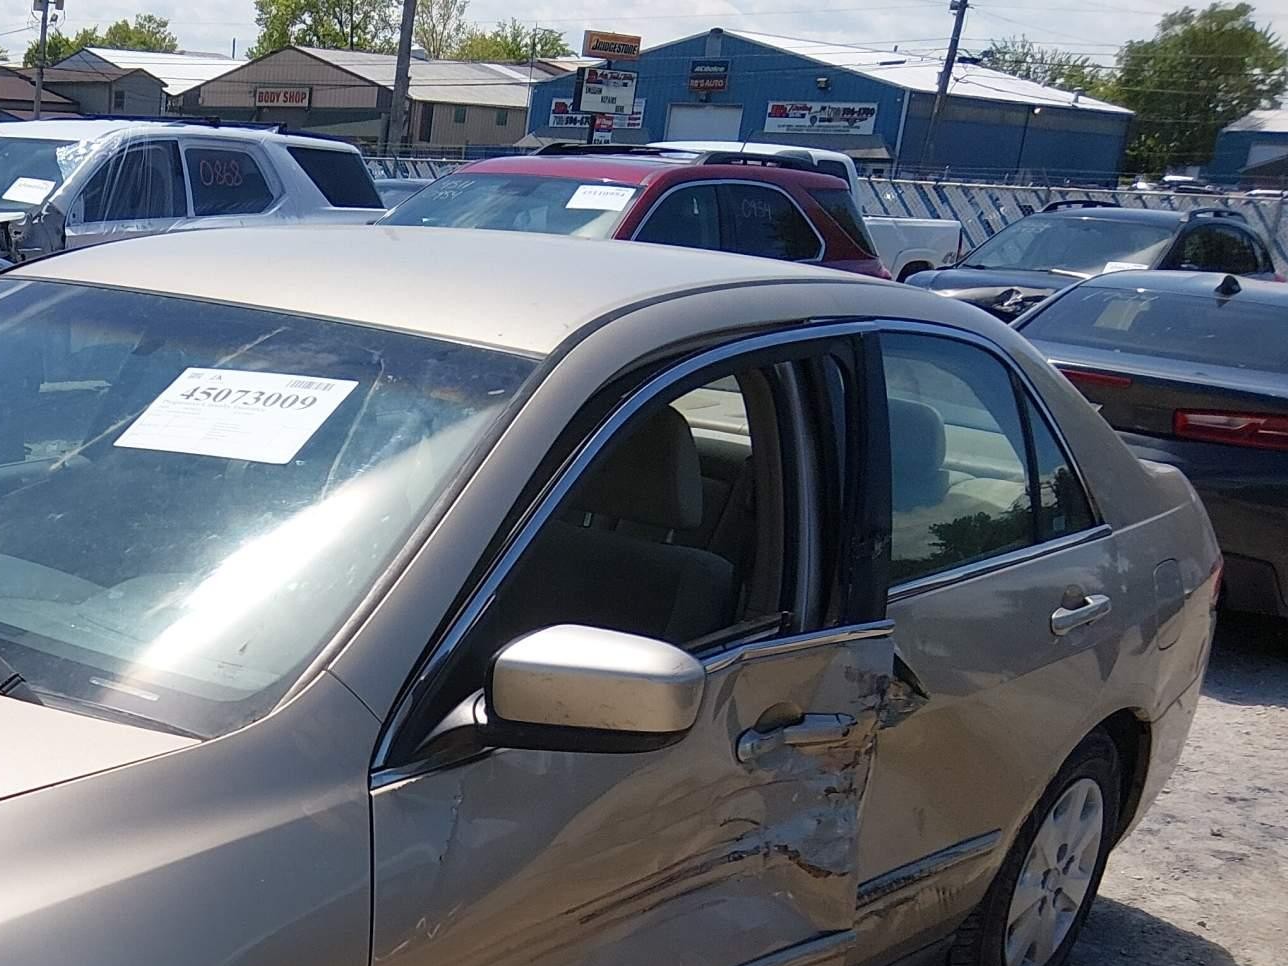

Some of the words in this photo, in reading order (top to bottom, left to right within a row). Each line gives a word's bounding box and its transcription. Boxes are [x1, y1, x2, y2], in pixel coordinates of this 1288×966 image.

[592, 39, 638, 55] BRIDGESTONE
[705, 79, 724, 88] AUTO
[258, 91, 281, 103] BODY
[282, 90, 307, 104] SHOP
[199, 160, 243, 186] 0868
[179, 385, 318, 411] 45073009
